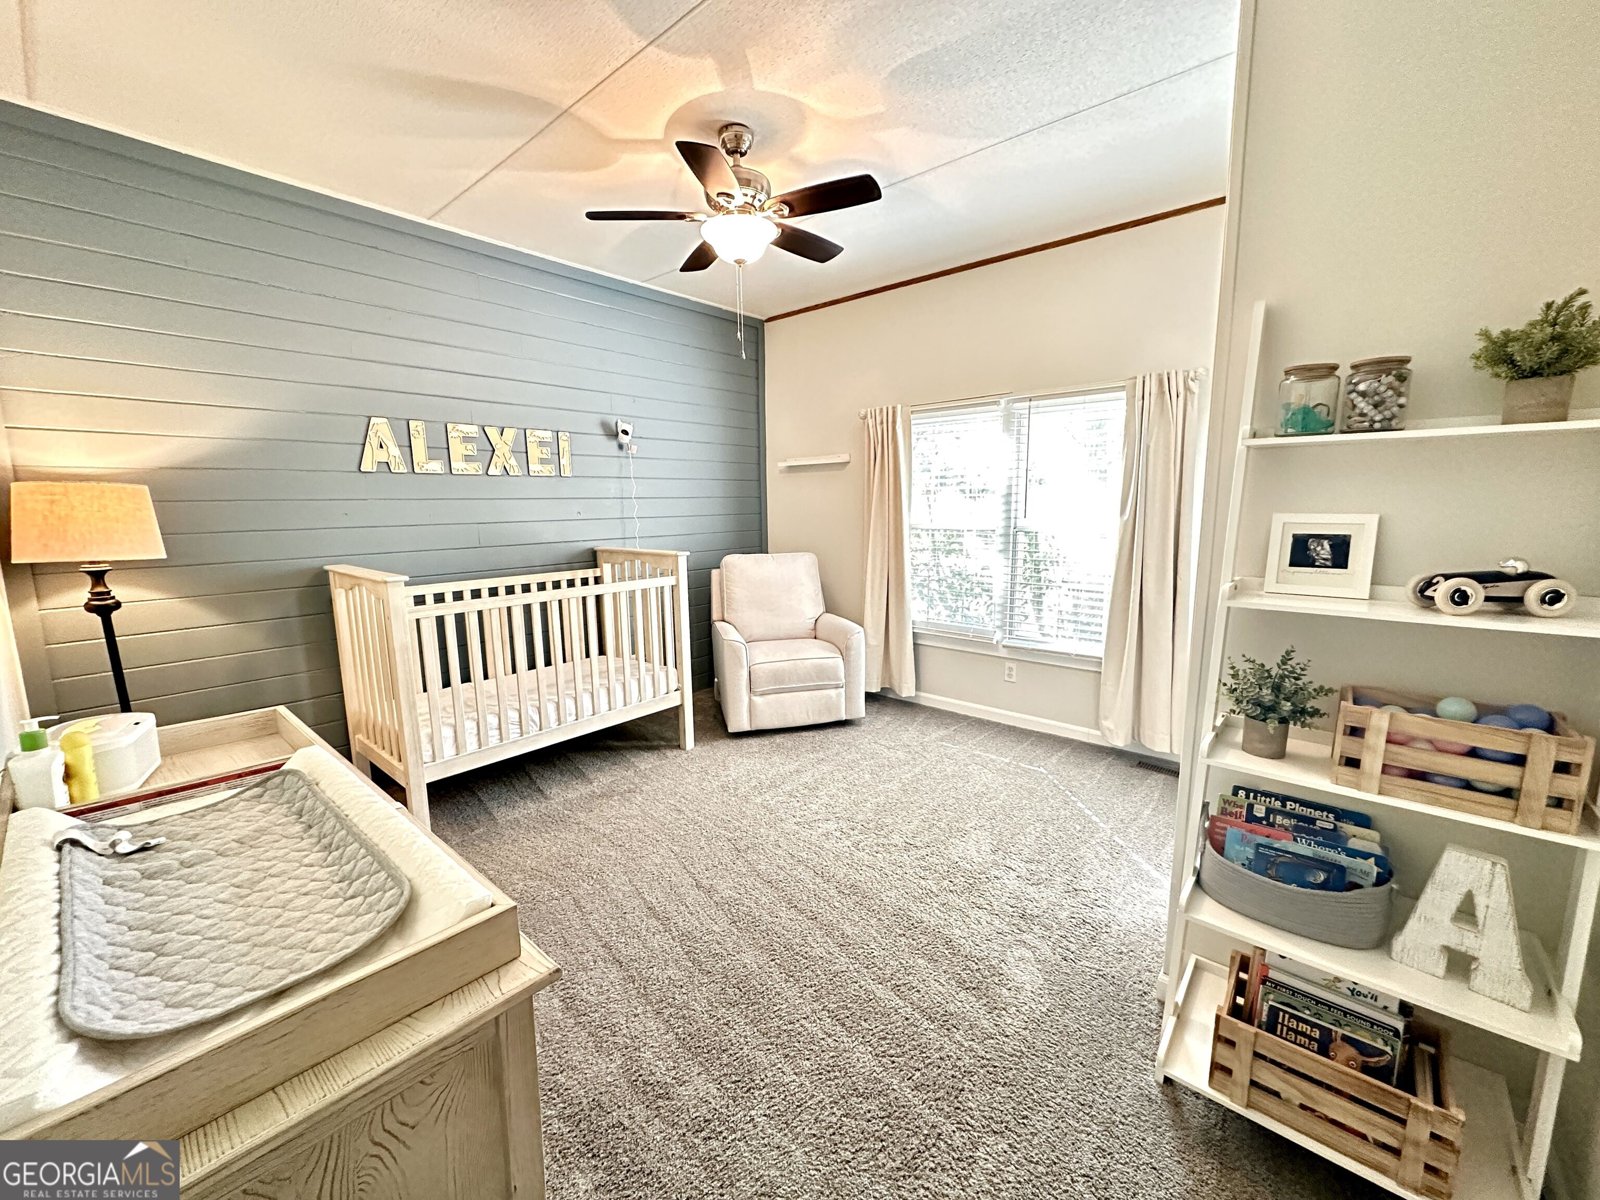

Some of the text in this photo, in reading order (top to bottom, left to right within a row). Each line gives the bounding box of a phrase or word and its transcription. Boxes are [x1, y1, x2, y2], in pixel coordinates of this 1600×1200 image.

[360, 416, 573, 477] ALEXEI
[1237, 790, 1335, 821] 8 Little Planets
[1269, 813, 1273, 822] I
[1391, 843, 1533, 1012] A
[1346, 986, 1378, 1002] You'll
[1276, 985, 1293, 995] FIRST
[1294, 992, 1316, 1005] TOUCH
[1330, 1006, 1344, 1016] FEEL
[1346, 1014, 1371, 1028] SOUND
[1372, 1024, 1394, 1037] BOOK
[1278, 1011, 1320, 1039] llama
[1276, 1023, 1318, 1052] llama
